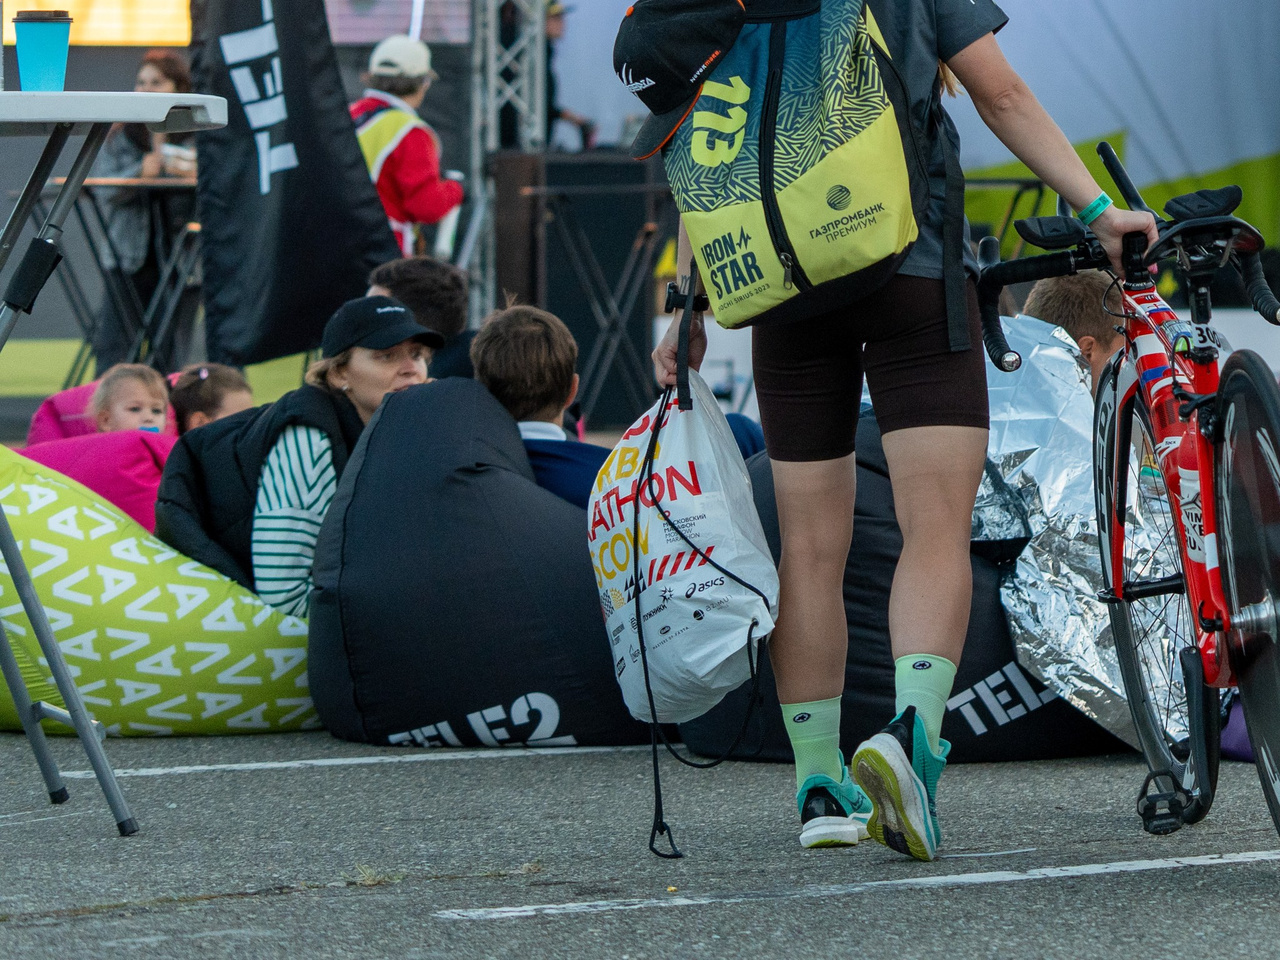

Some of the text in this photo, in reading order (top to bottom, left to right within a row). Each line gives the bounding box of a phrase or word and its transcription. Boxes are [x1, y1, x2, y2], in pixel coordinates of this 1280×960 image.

[690, 75, 751, 168] 113
[809, 202, 885, 239] ГАЗПРОМБАНК
[825, 217, 877, 244] ПРЕМИУМ
[701, 232, 737, 270] IRON
[710, 251, 765, 301] STAR
[734, 290, 754, 306] SIRIUS
[755, 283, 771, 296] 2023
[587, 460, 702, 543] ATHON
[662, 513, 707, 528] МСКОВСКИЙ
[664, 521, 696, 533] МААФОН
[665, 527, 694, 539] MOSOW
[666, 532, 701, 544] MARHON
[698, 576, 725, 593] asics
